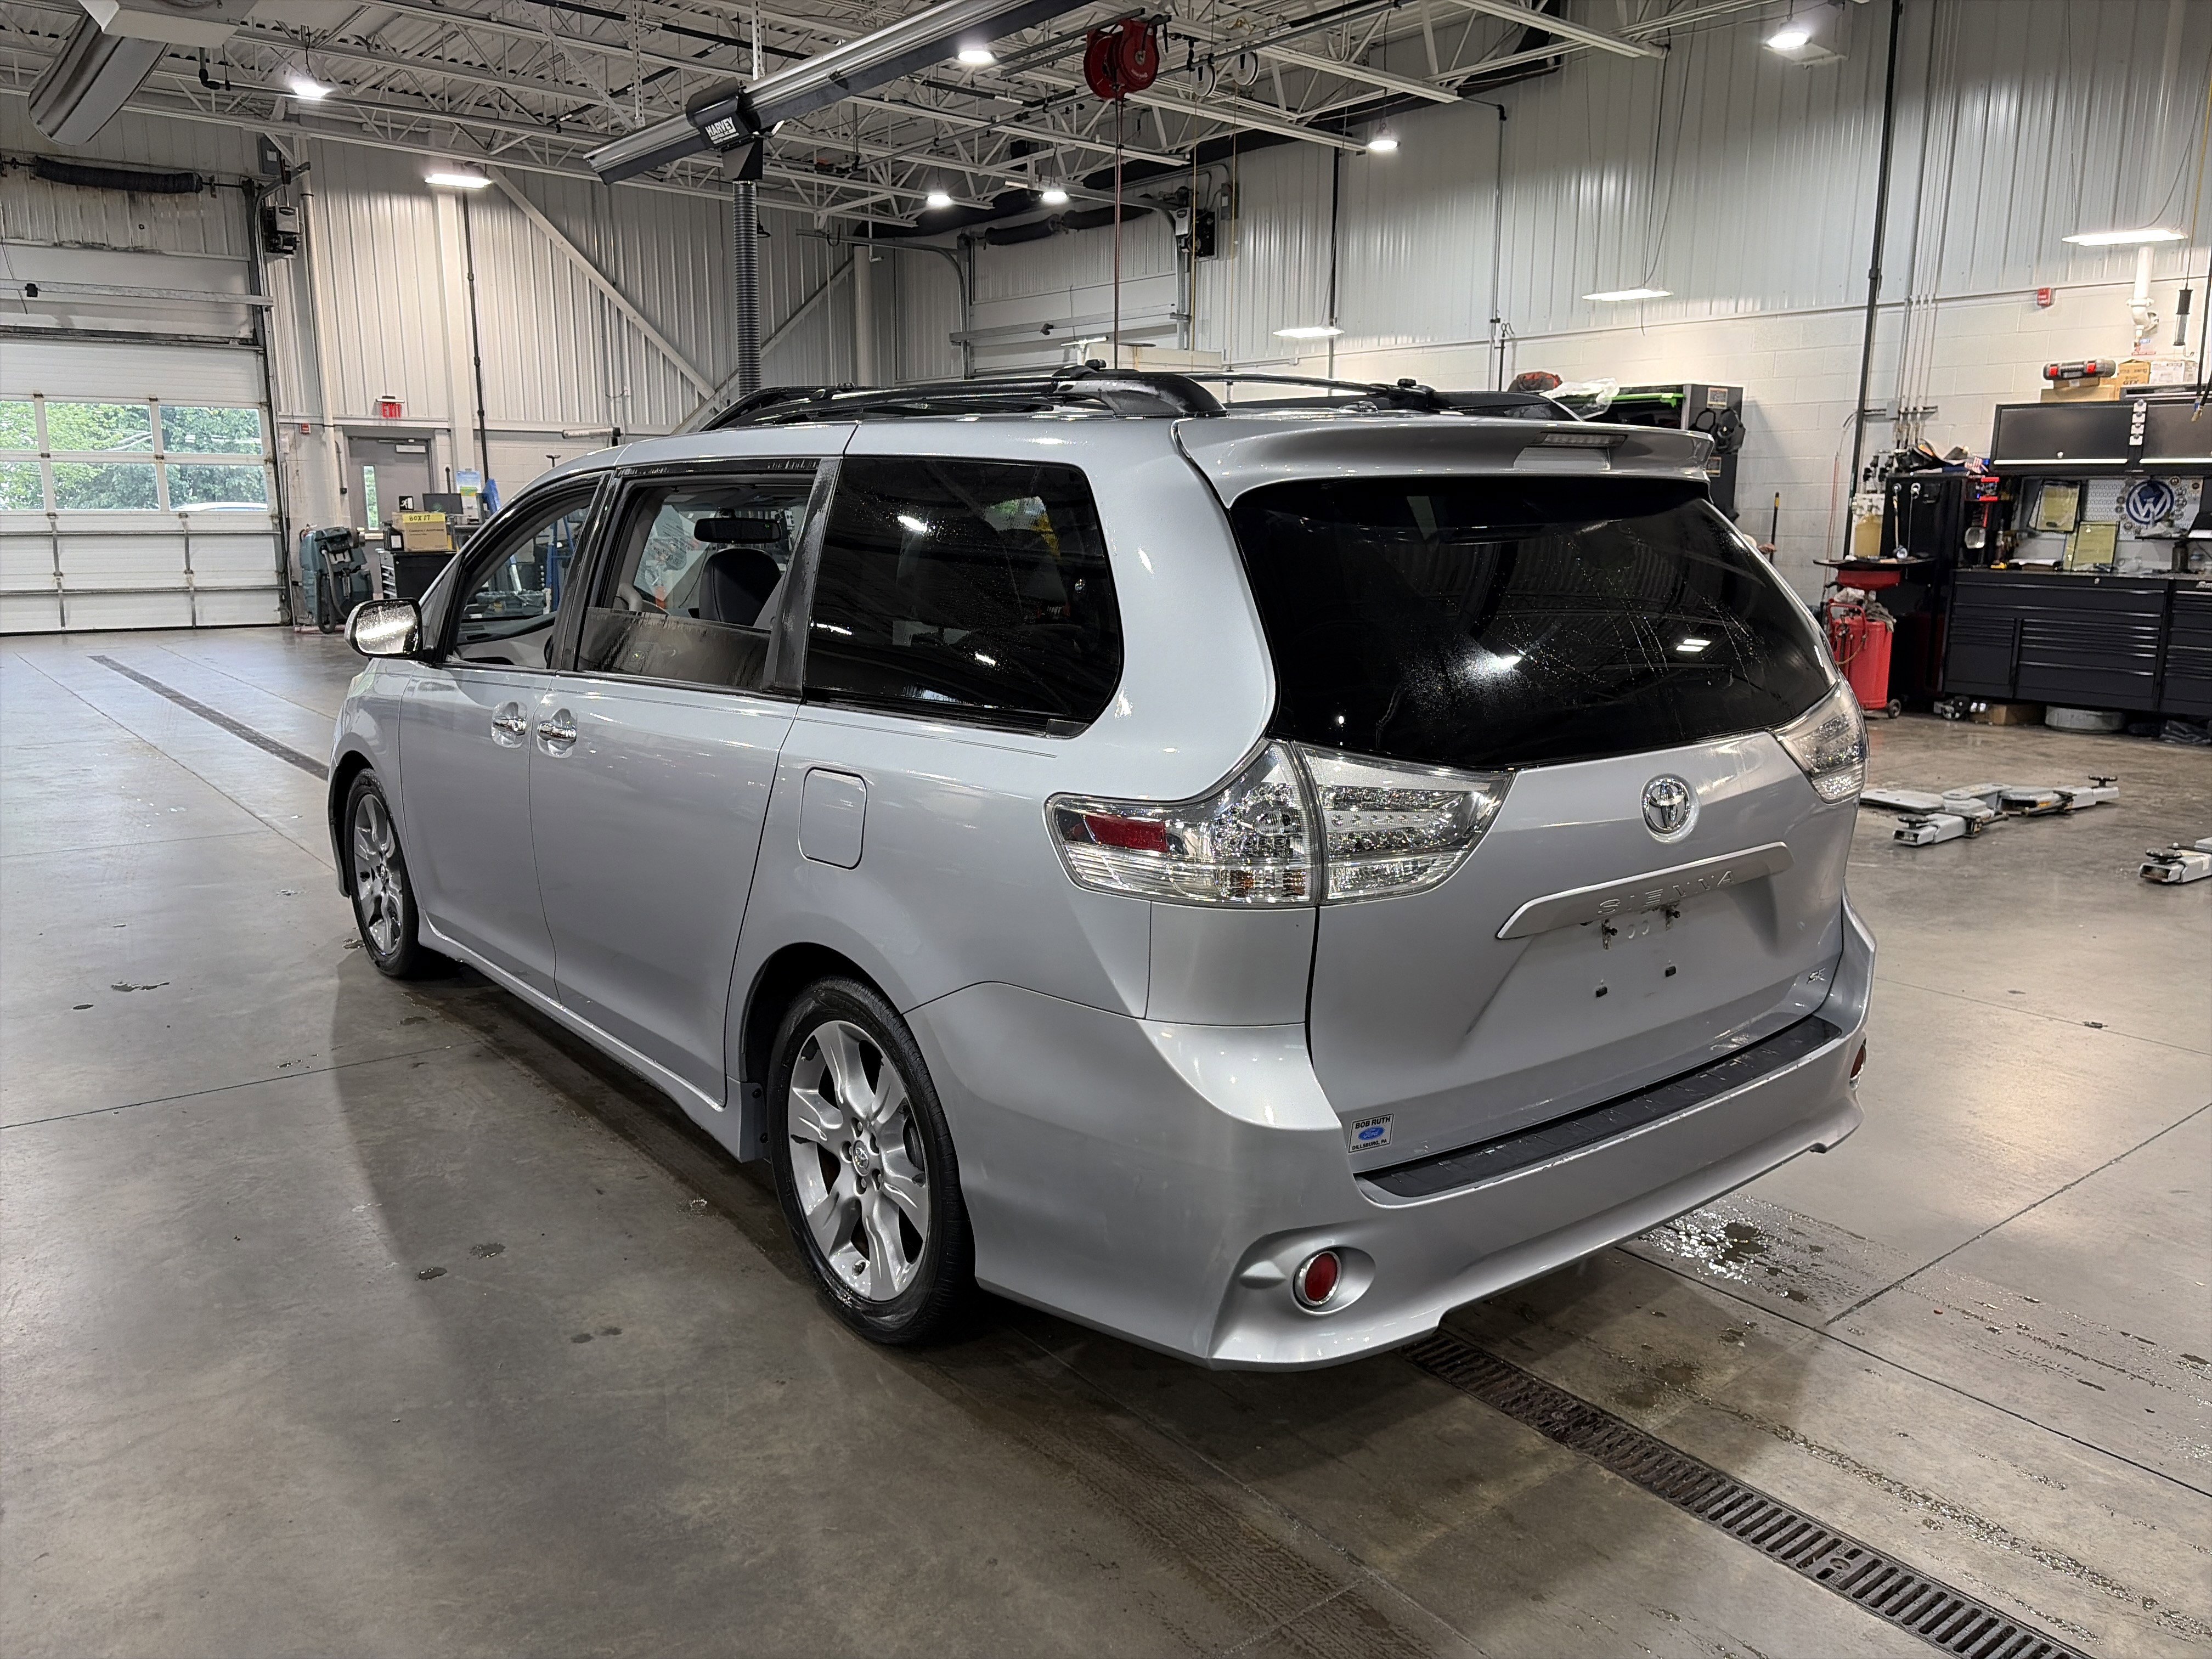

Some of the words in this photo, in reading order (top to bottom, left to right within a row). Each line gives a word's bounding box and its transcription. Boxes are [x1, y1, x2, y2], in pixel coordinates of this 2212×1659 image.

[704, 116, 737, 137] HARVEY
[382, 403, 401, 417] EXIT
[1355, 1120, 1370, 1129] BOB
[1372, 1116, 1391, 1126] RUTH
[1352, 1141, 1380, 1150] DILLSBURG,
